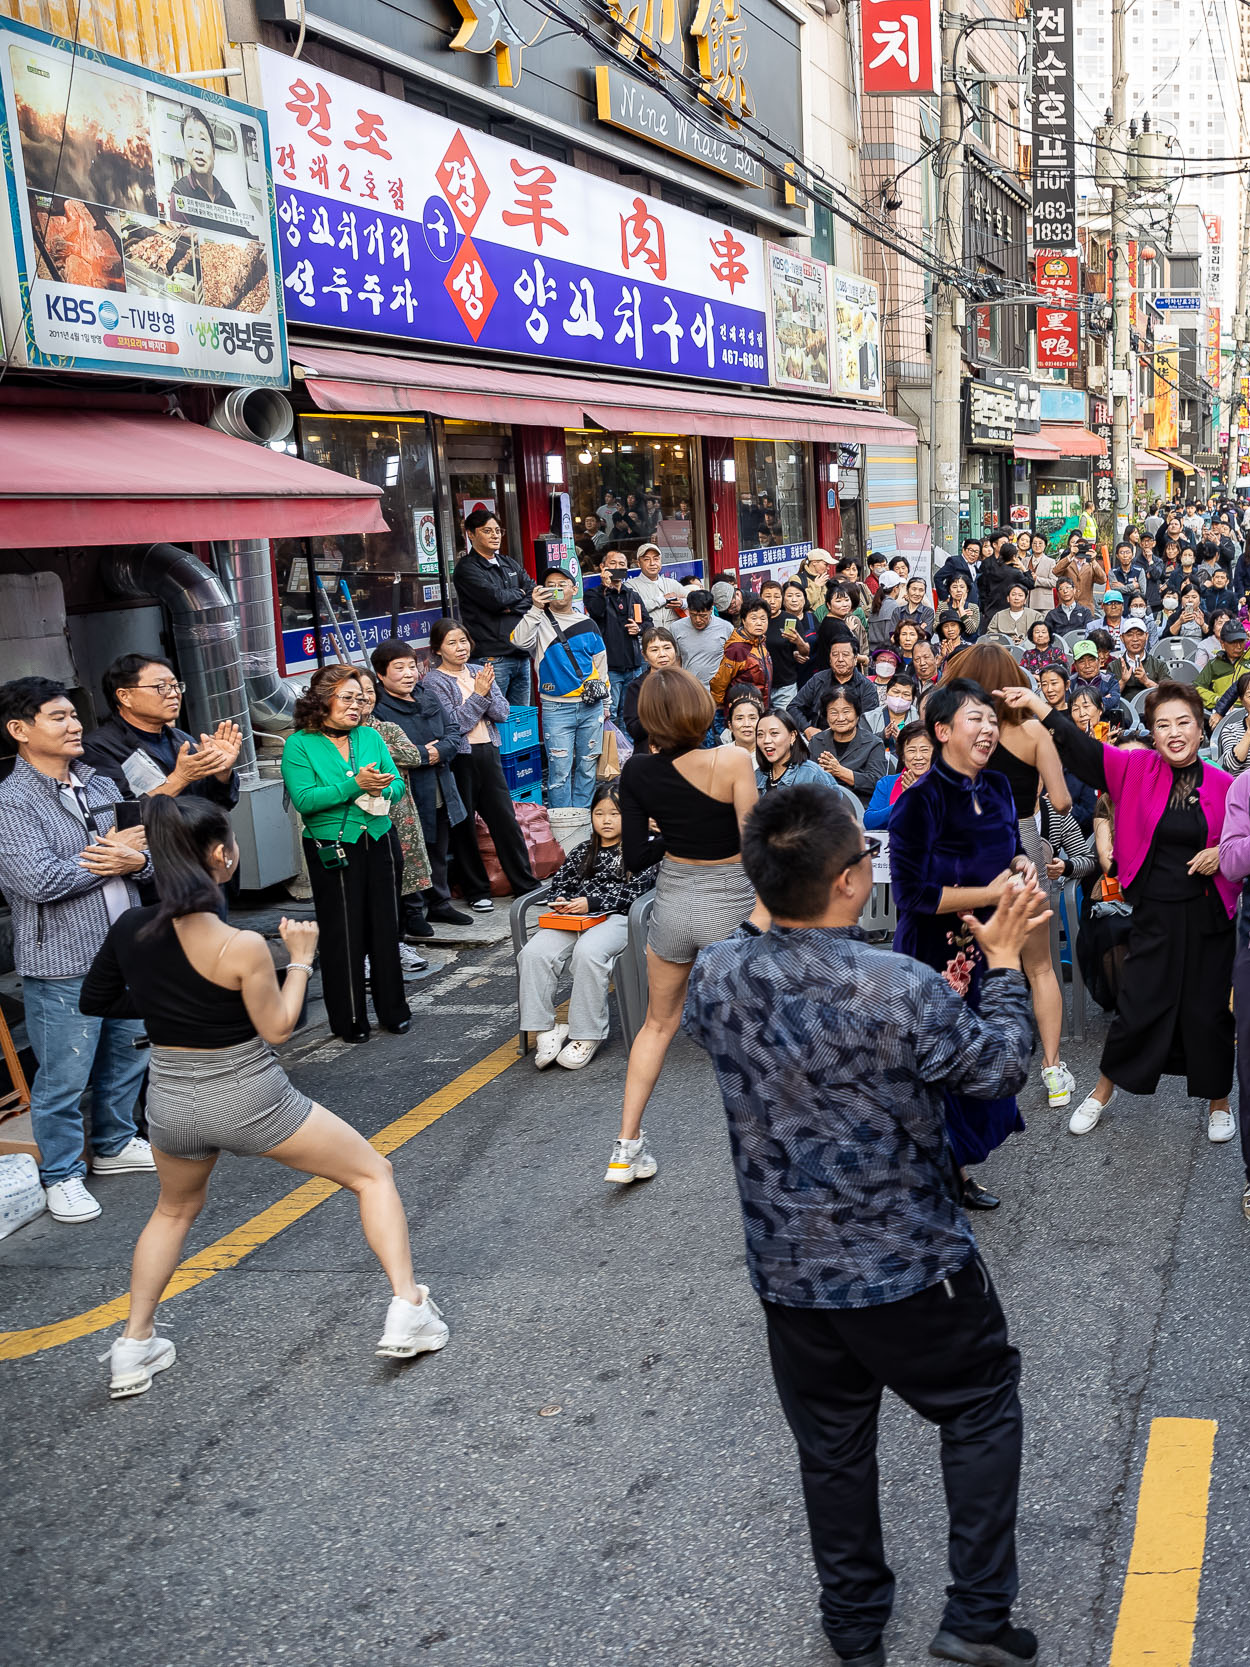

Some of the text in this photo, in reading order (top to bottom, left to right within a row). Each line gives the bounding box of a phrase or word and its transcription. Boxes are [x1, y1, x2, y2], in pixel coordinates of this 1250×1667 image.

[286, 78, 392, 160] 원조
[1037, 7, 1067, 166] 천수호프
[620, 83, 760, 178] Nine Whale Bar
[1034, 201, 1074, 219] 463-
[1037, 171, 1071, 189] HOF
[502, 158, 750, 295] 羊肉串
[1034, 223, 1072, 241] 1833
[45, 293, 175, 335] KBS -TV방영
[284, 259, 419, 324] 선두주자
